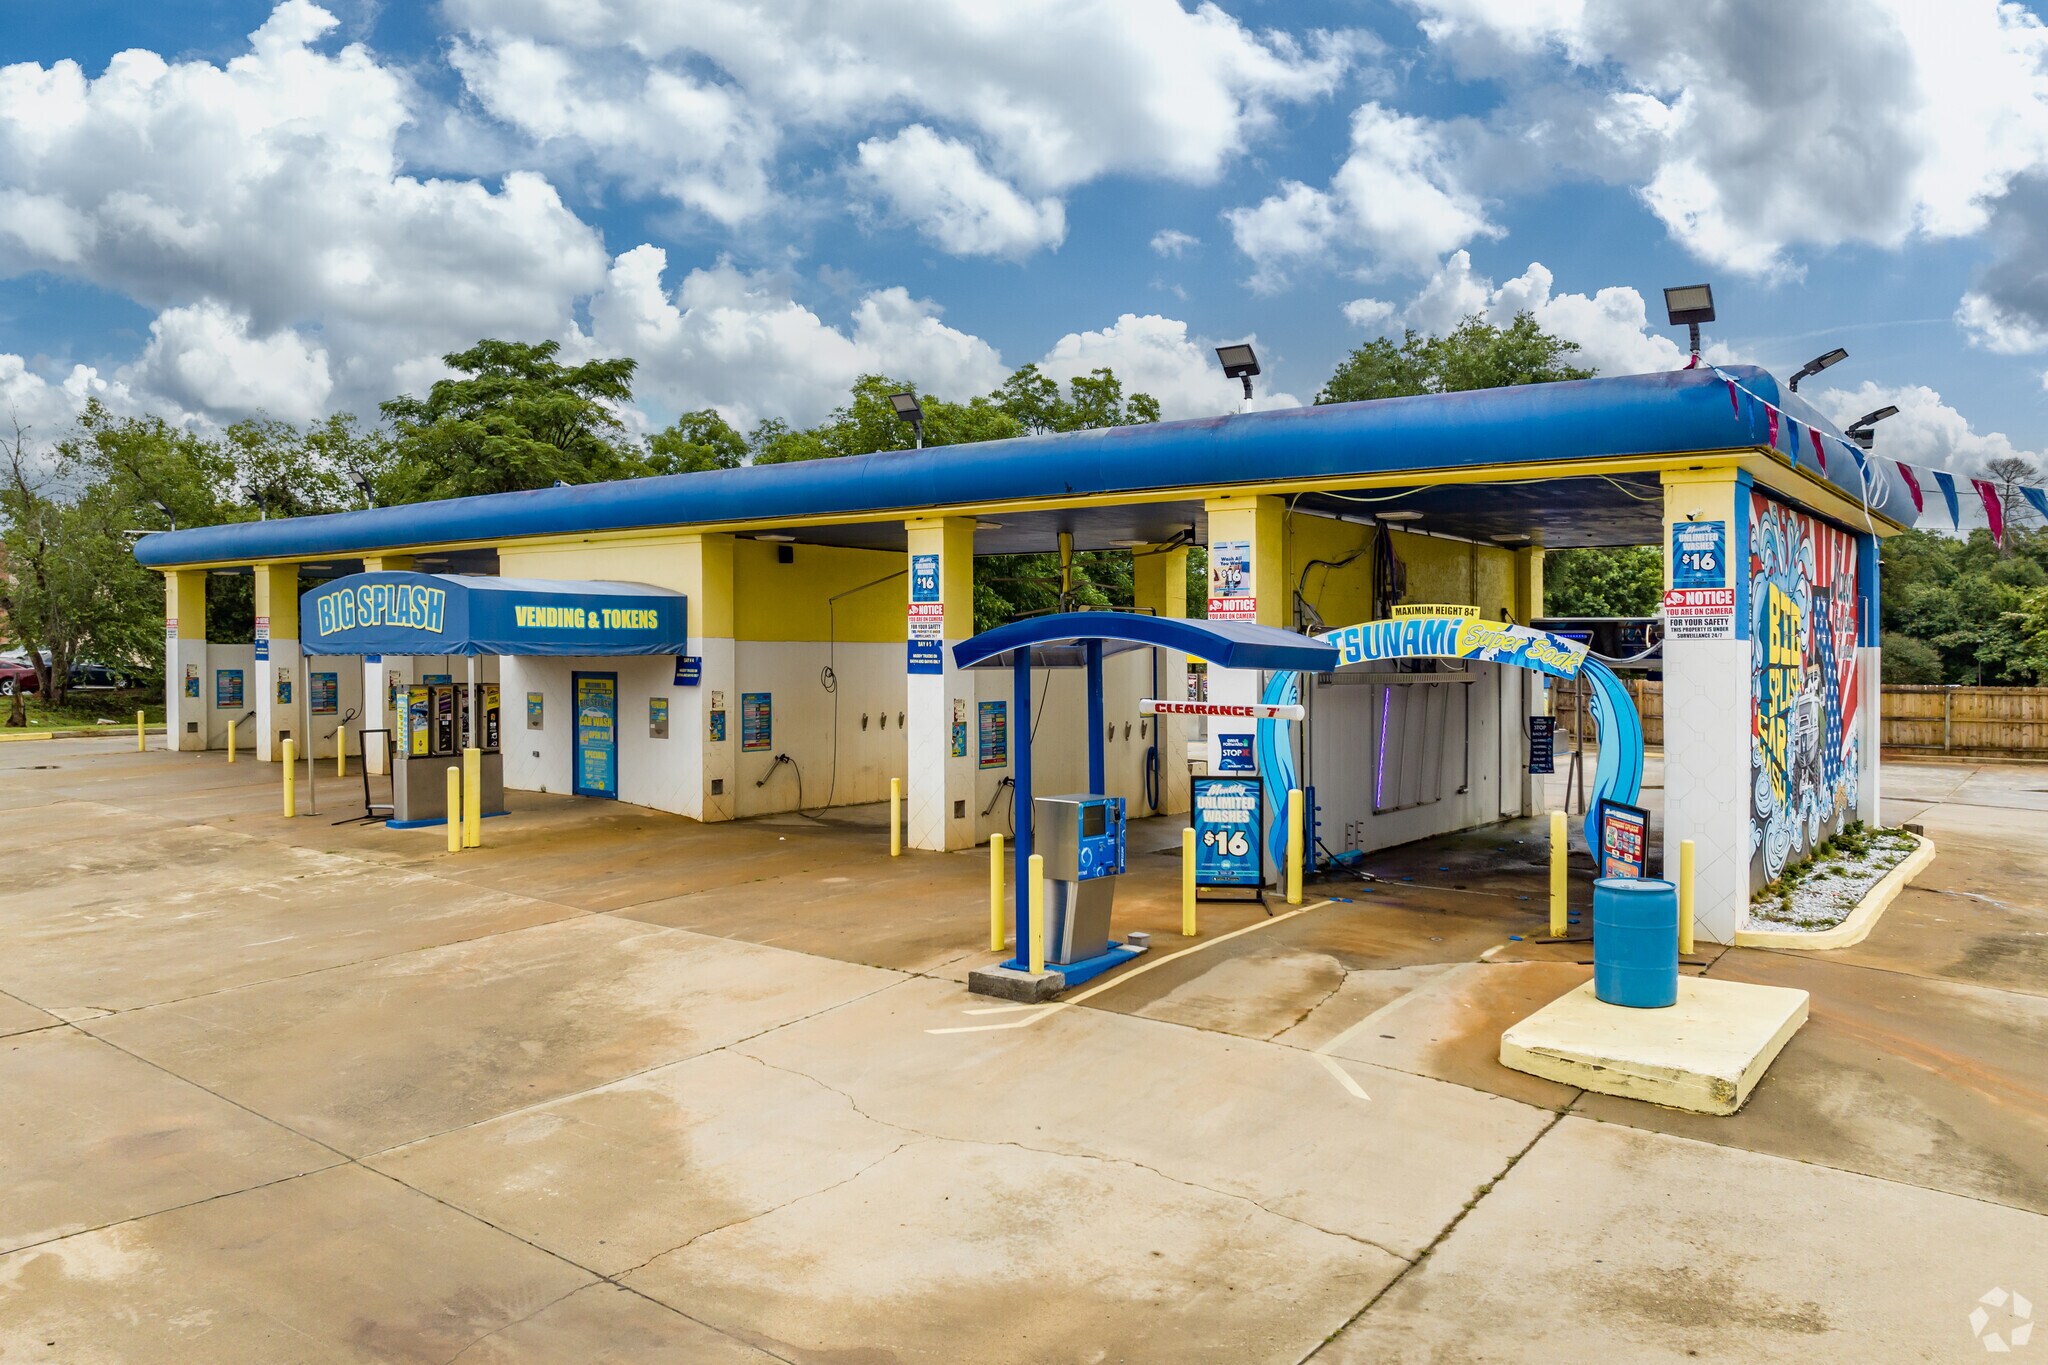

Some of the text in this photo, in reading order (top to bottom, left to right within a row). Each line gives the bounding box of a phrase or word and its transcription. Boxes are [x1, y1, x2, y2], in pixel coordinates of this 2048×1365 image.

[1679, 533, 1718, 542] UNLIMITED
[1683, 542, 1714, 551] WASHES
[1682, 552, 1716, 571] $16
[1221, 569, 1242, 582] $16
[917, 576, 934, 589] $16
[1685, 590, 1733, 605] NOTICE
[317, 584, 446, 637] BIG SPLASH
[919, 605, 943, 615] NOTICE
[1223, 599, 1255, 611] NOTICE
[1395, 605, 1434, 616] MAXIMUM
[1435, 606, 1463, 616] HEIGHT
[1666, 608, 1679, 616] YOU
[1681, 608, 1693, 616] ARE
[1705, 607, 1733, 615] CAMERA
[515, 606, 658, 629] VENDING & TOKENS
[1704, 618, 1729, 626] SAFETY
[1769, 582, 1801, 666] BIG
[1463, 623, 1528, 654] Super
[1525, 638, 1581, 674] Soak
[1769, 668, 1801, 717] SPLASH
[1155, 703, 1254, 717] CLEARANCE
[579, 716, 613, 727] CAR WASH
[1758, 707, 1787, 772] CAR
[1222, 749, 1242, 757] STOP
[1207, 783, 1246, 797] Monthly
[1197, 796, 1256, 810] UNLIMITED
[1203, 810, 1250, 823] WASHES
[1203, 830, 1250, 857] $16
